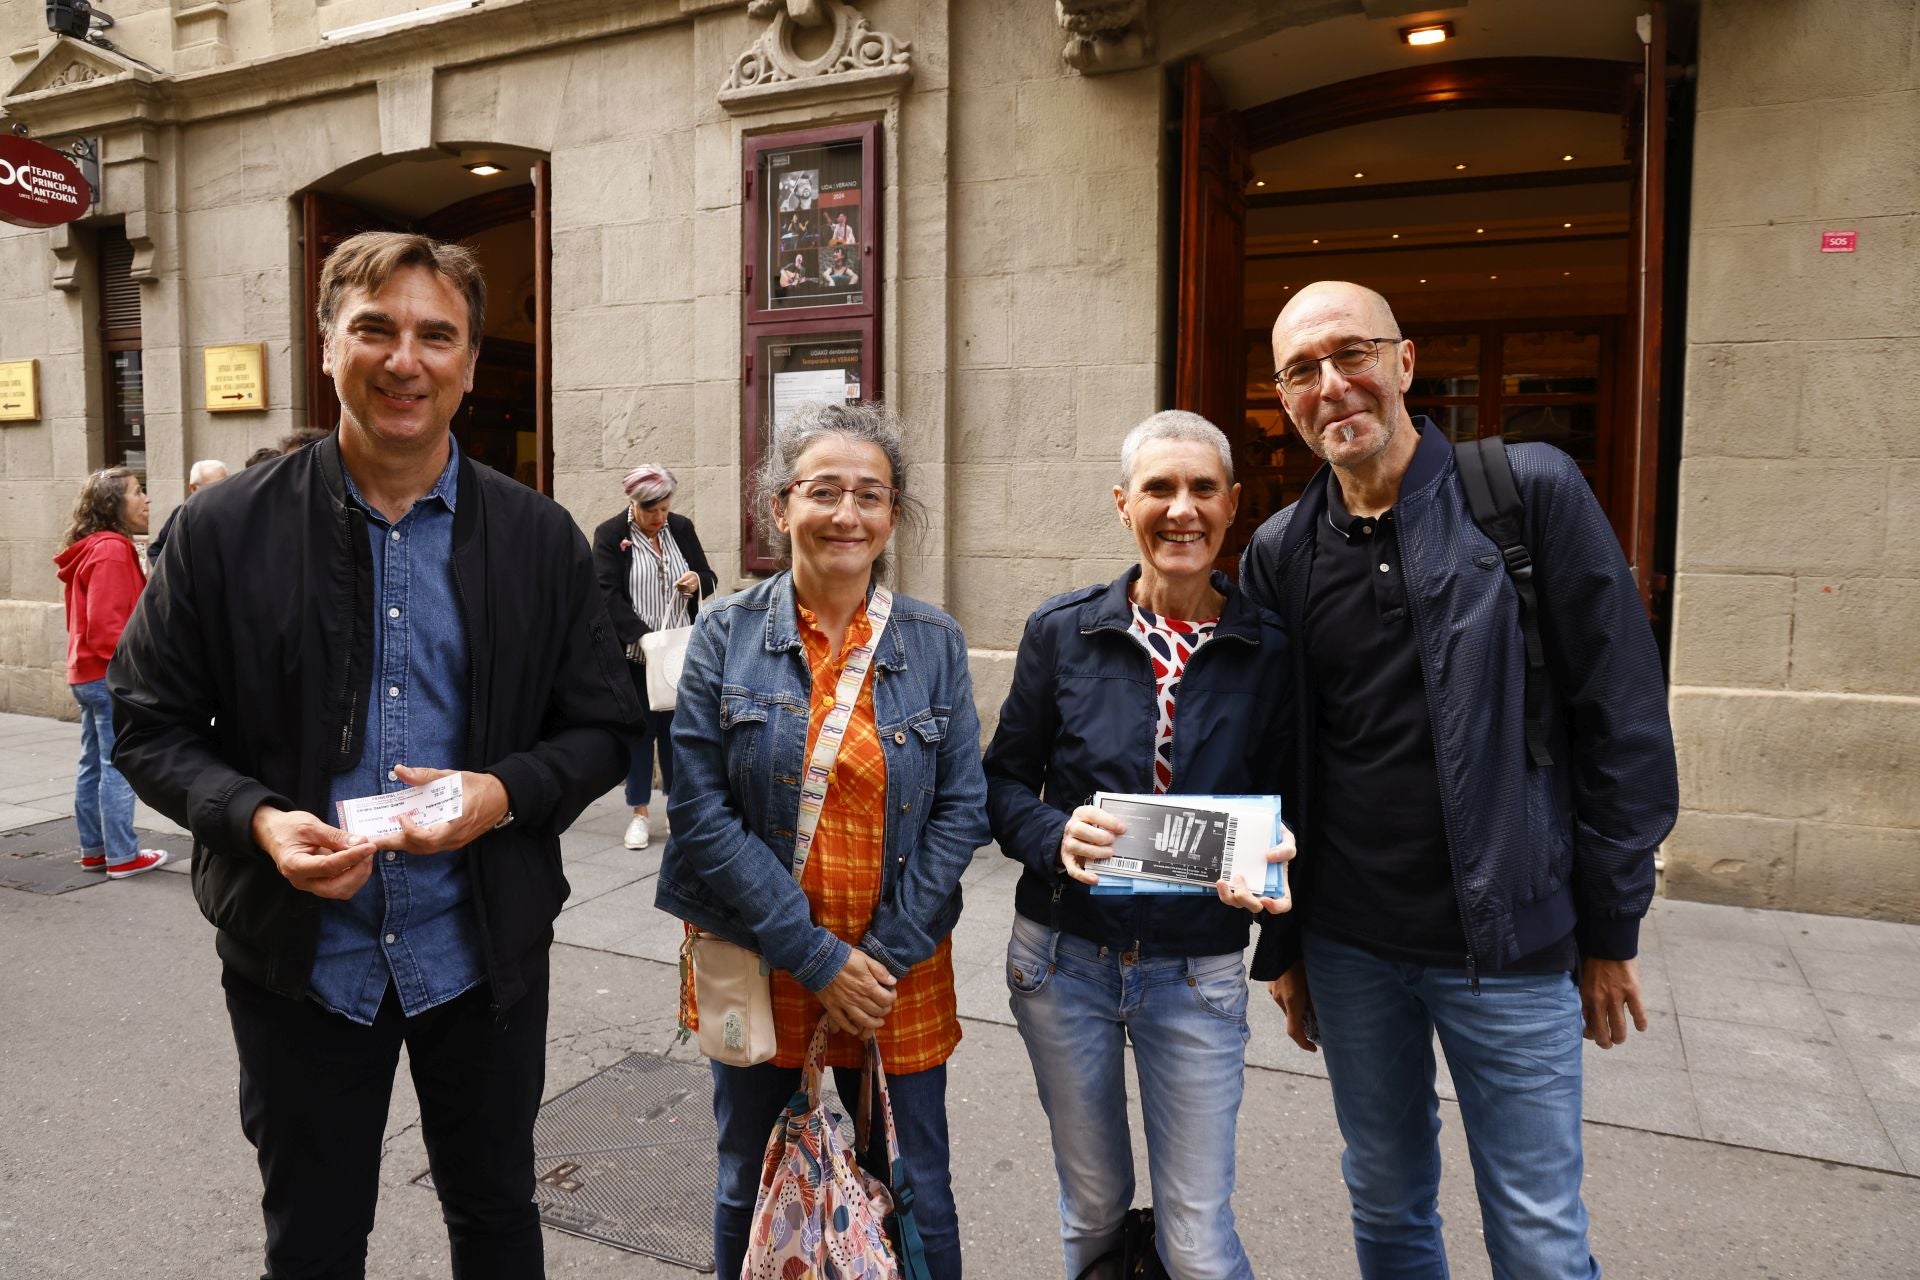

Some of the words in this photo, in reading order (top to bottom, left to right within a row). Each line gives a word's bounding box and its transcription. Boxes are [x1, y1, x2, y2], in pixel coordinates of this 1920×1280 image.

[31, 166, 65, 182] TEATRO
[32, 176, 79, 195] PRINCIPAL
[835, 180, 858, 189] VERANO
[33, 187, 78, 204] ANTZOKIA
[832, 192, 845, 201] 2024
[1829, 237, 1848, 246] SOS
[837, 355, 859, 364] VERANO
